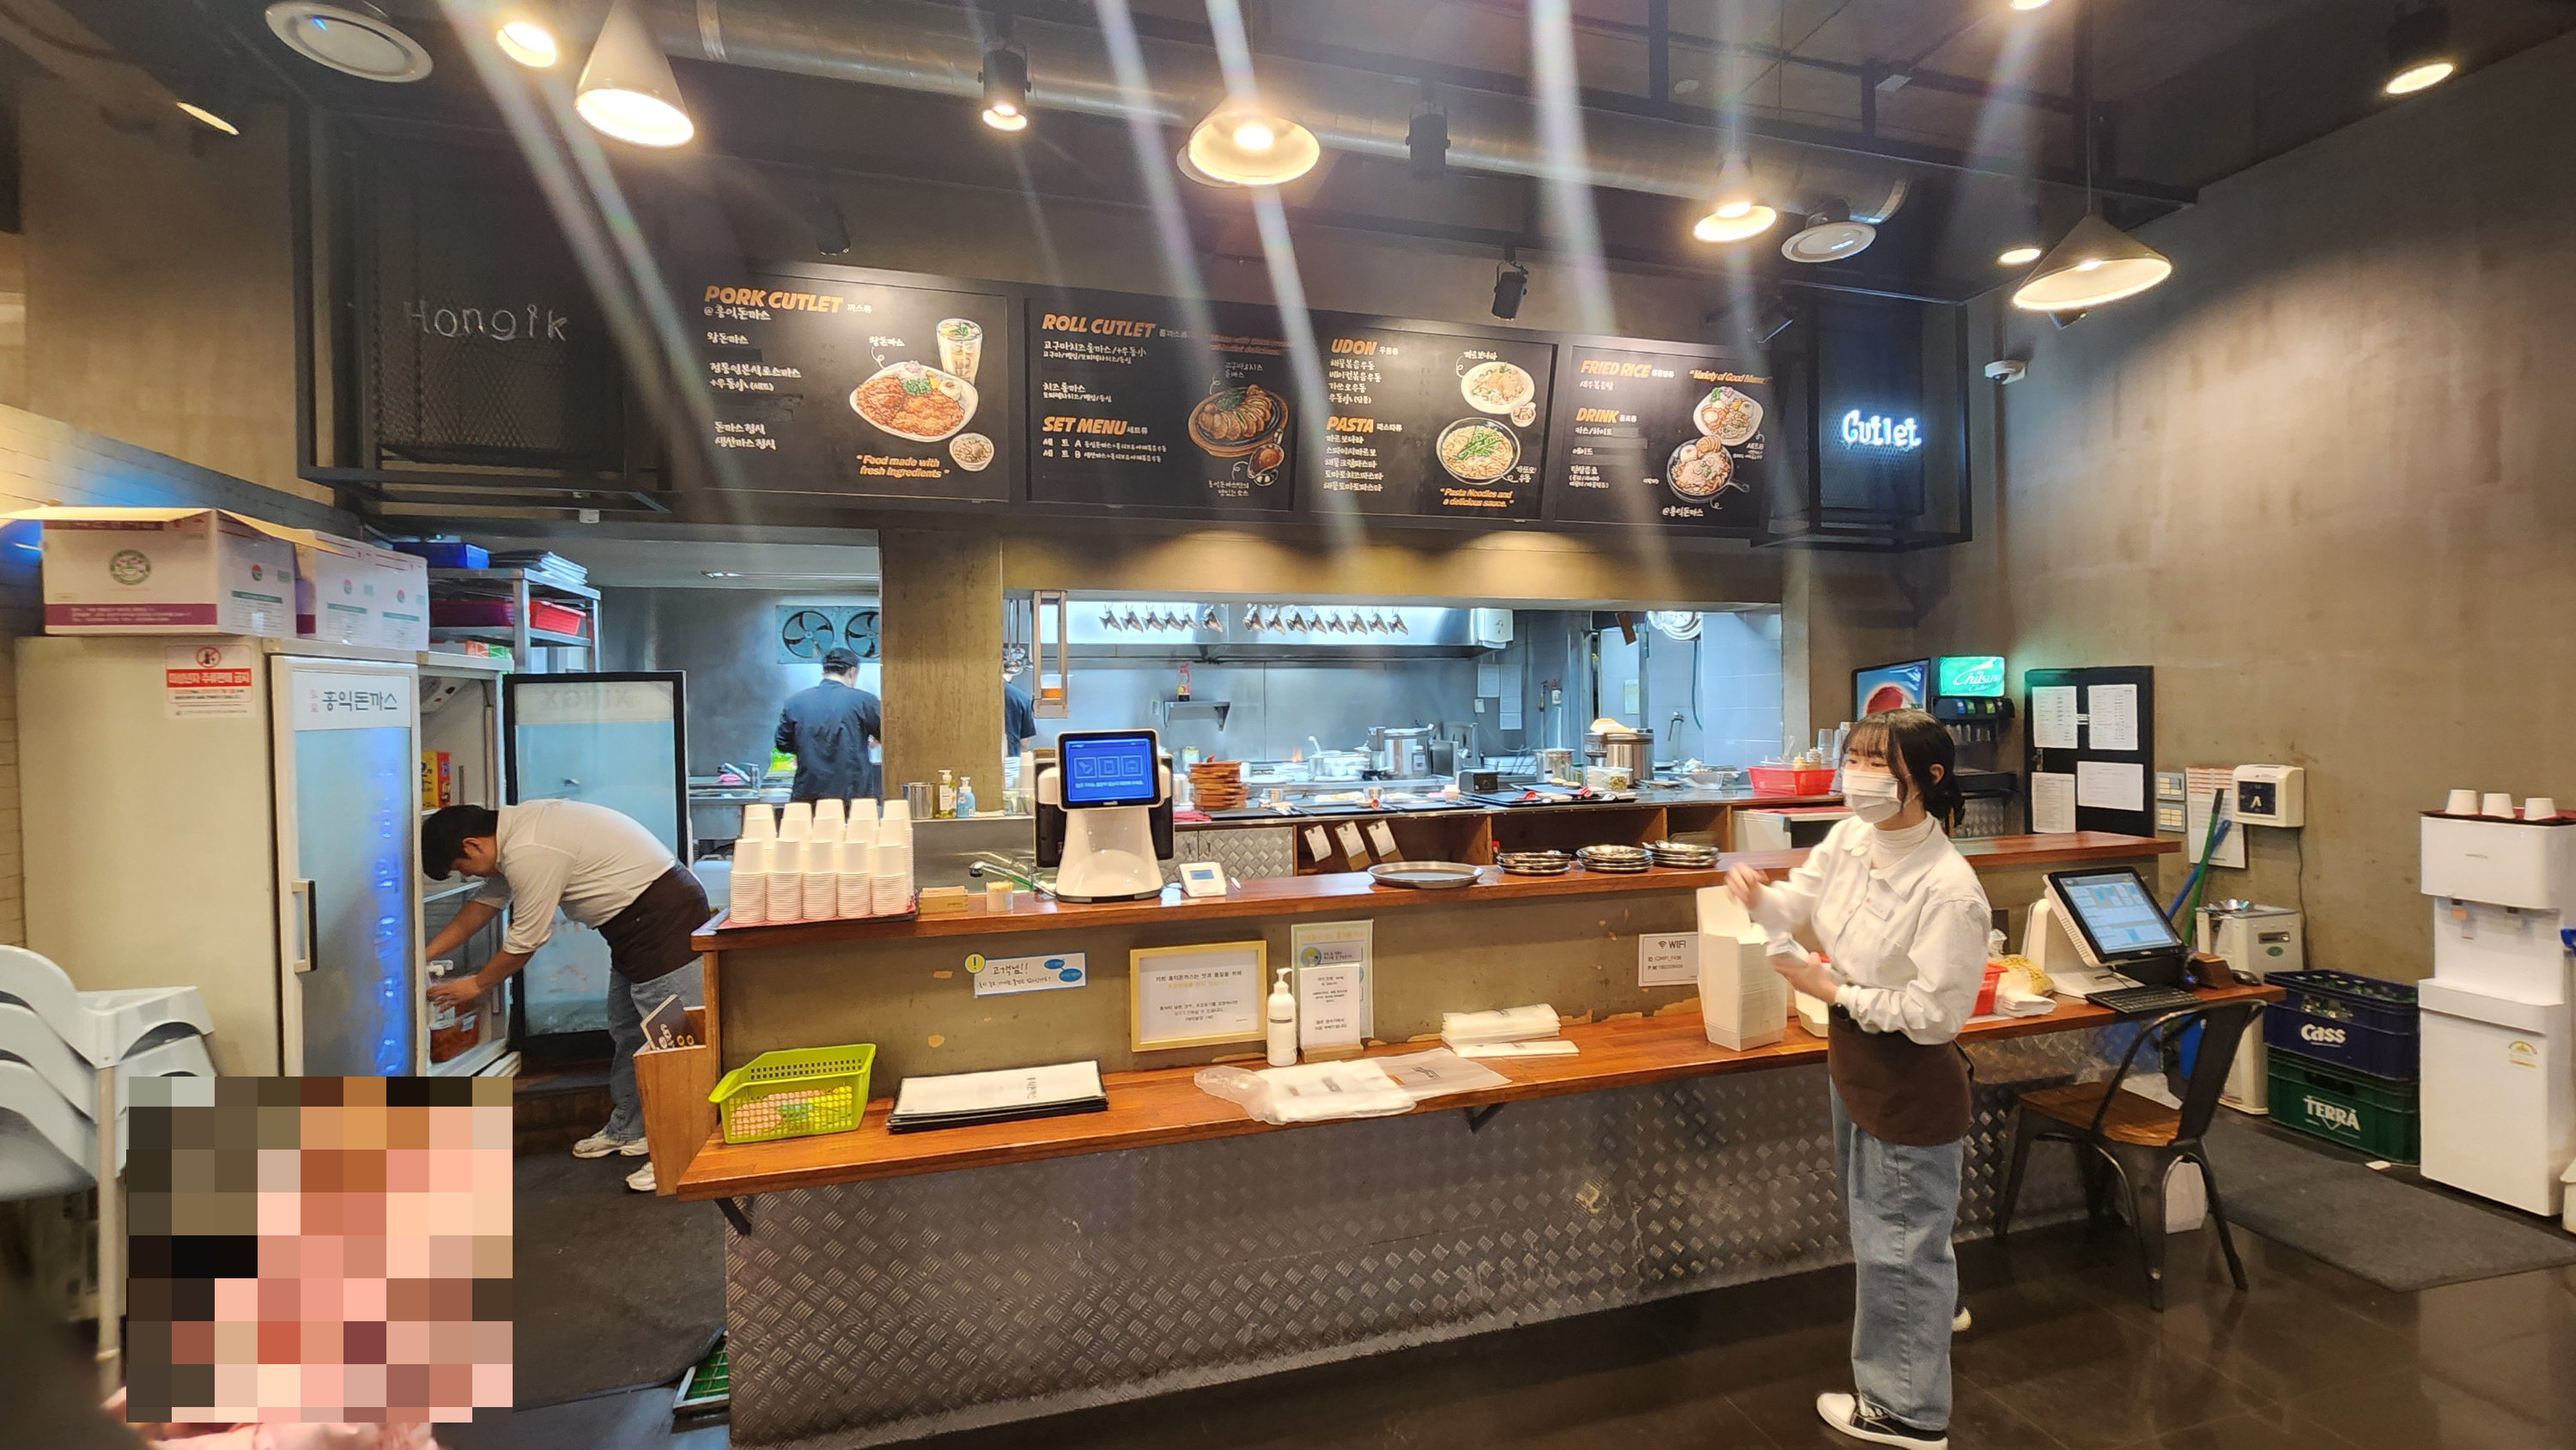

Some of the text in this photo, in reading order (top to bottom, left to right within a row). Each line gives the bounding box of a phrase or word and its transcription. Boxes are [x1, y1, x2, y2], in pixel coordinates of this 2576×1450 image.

[704, 285, 844, 313] PORK CUTLET
[404, 300, 568, 341] Hongik
[1042, 313, 1157, 338] ROLL CUTLET
[1331, 338, 1377, 355] UDON
[1580, 359, 1652, 378] FRIED RICE
[1326, 416, 1374, 433] PASTA
[1575, 407, 1620, 423] DRINK
[1042, 416, 1127, 436] SET MENU
[1842, 410, 1922, 446] Cutlet
[860, 465, 885, 476] fresh
[889, 457, 918, 467] made
[919, 458, 940, 468] with
[1449, 497, 1483, 507] delicious
[1467, 488, 1497, 498] Noodles
[322, 690, 398, 712] 홍익돈까스
[2300, 1023, 2347, 1044] Cass
[2303, 1096, 2360, 1131] TERRA
